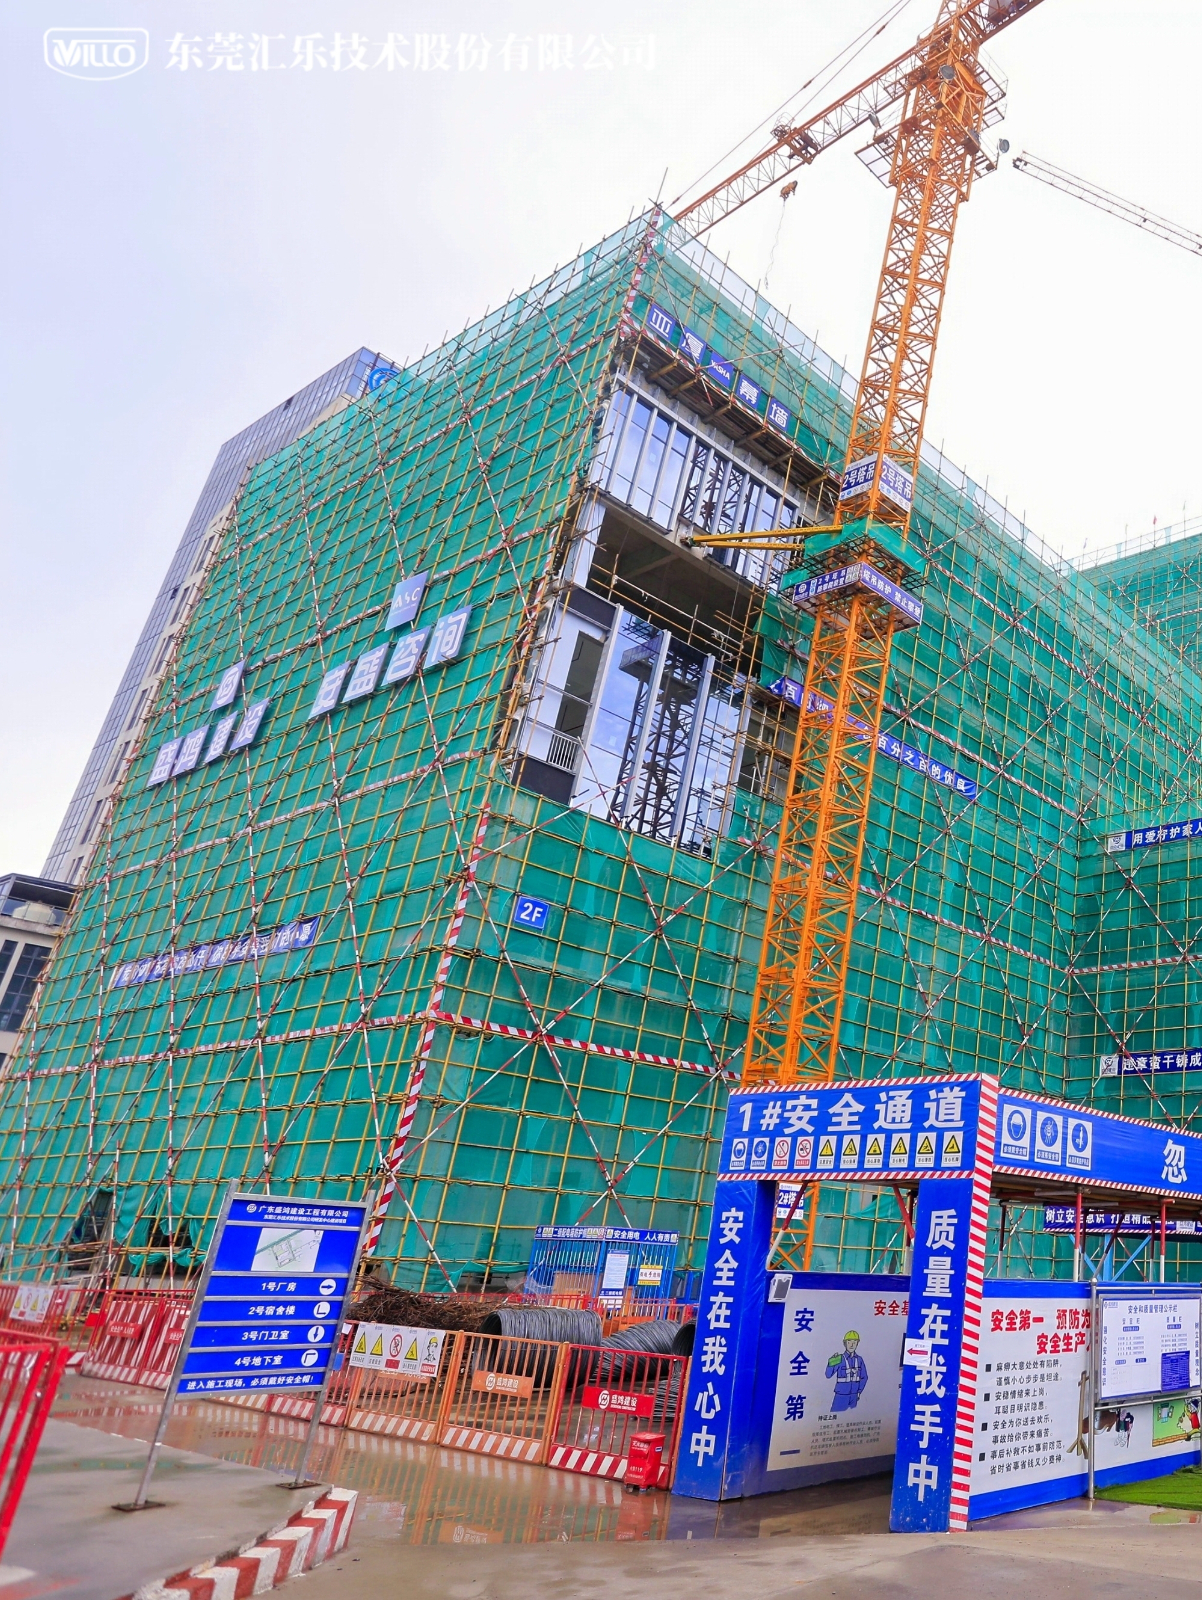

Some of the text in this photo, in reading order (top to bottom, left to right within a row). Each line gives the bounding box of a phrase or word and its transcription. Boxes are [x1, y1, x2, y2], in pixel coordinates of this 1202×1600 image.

[842, 463, 876, 488] 2号塔吊
[881, 465, 912, 499] 2号塔吊
[520, 902, 543, 923] 2F
[738, 1086, 966, 1135] 1#安全通道
[258, 1205, 349, 1218] 广东盛鸿建设工程有限公司
[613, 1230, 640, 1241] 安全用电
[644, 1232, 671, 1243] 人人有责
[261, 1282, 297, 1293] 1号厂房
[248, 1305, 296, 1317] 2号宿舍楼
[991, 1308, 1044, 1333] 安全第一
[241, 1330, 290, 1342] 3号门卫室
[689, 1207, 745, 1467] 安全在我心中
[234, 1354, 283, 1367] 4号地下室
[907, 1209, 958, 1503] 质量在我手中
